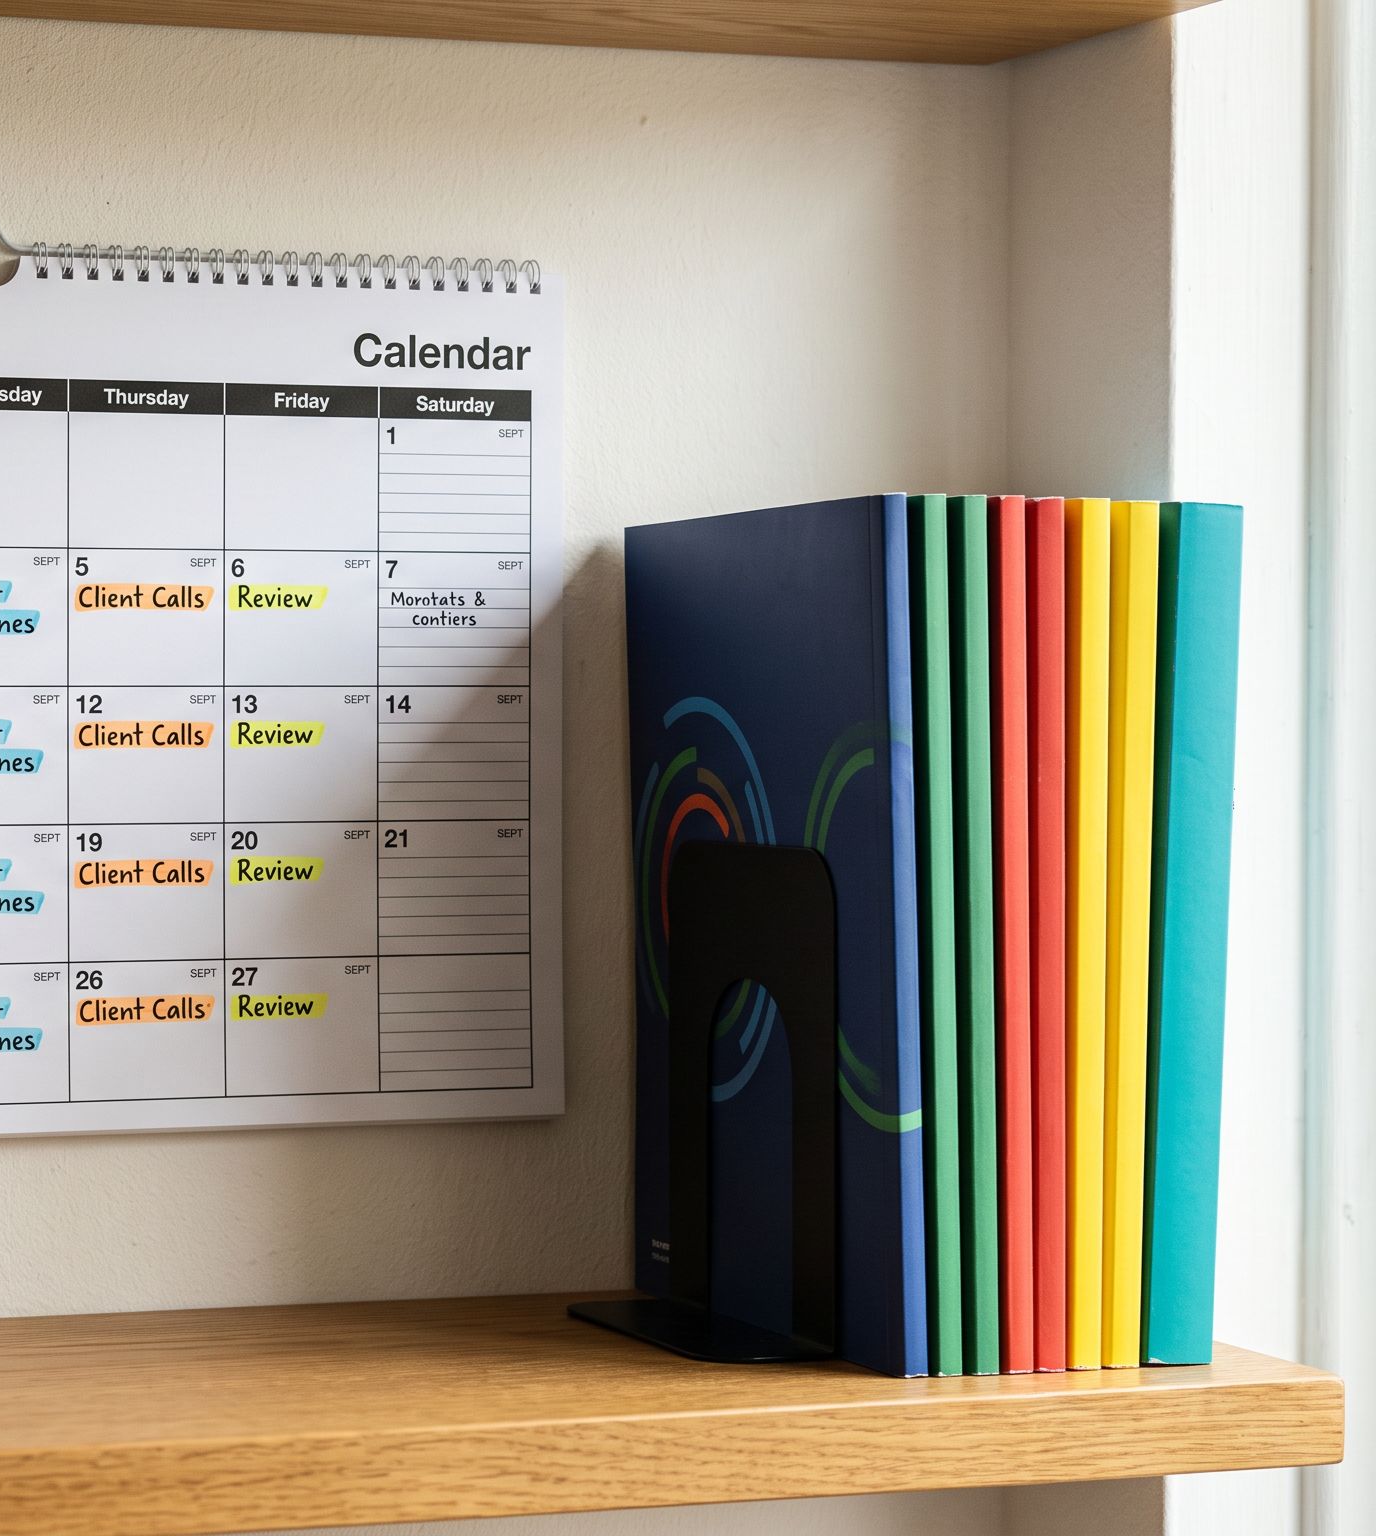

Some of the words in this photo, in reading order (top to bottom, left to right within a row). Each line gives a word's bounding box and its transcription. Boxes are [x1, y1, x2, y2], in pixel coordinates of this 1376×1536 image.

[353, 332, 531, 371] Calendar
[103, 388, 190, 410] Thursday
[274, 392, 330, 413] Friday
[416, 395, 495, 417] Saturday
[386, 426, 395, 445] 1
[498, 428, 524, 438] SEPT
[33, 556, 61, 566] SEPT
[75, 556, 89, 577] 5
[190, 557, 217, 568] SEPT
[231, 558, 245, 578] 6
[344, 559, 371, 569] SEPT
[385, 560, 398, 579] 7
[497, 560, 523, 570] SEPT
[78, 584, 144, 608] Client
[152, 585, 205, 609] Calls
[238, 584, 313, 608] Review
[391, 591, 465, 607] Morotats
[474, 591, 486, 607] &
[412, 610, 477, 627] contiers
[32, 694, 60, 705] SEPT
[76, 694, 103, 714] 12
[189, 694, 217, 705] SEPT
[231, 694, 258, 714] 13
[344, 694, 370, 704] SEPT
[385, 694, 412, 714] 14
[497, 694, 523, 704] SEPT
[78, 722, 144, 747] Client
[151, 722, 205, 746] Calls
[237, 721, 314, 745] Review
[33, 833, 61, 843] SEPT
[76, 832, 103, 853] 19
[190, 831, 217, 842] SEPT
[231, 830, 258, 851] 20
[344, 830, 371, 840] SEPT
[384, 829, 408, 849] 21
[497, 828, 524, 838] SEPT
[79, 860, 144, 886] Client
[152, 859, 205, 884] Calls
[237, 858, 314, 882] Review
[33, 971, 61, 982] SEPT
[190, 968, 217, 979] SEPT
[231, 966, 258, 987] 27
[344, 964, 371, 975] SEPT
[75, 970, 103, 990] 26
[79, 997, 145, 1023] Client
[152, 996, 206, 1021] Calls
[238, 994, 314, 1018] Review
